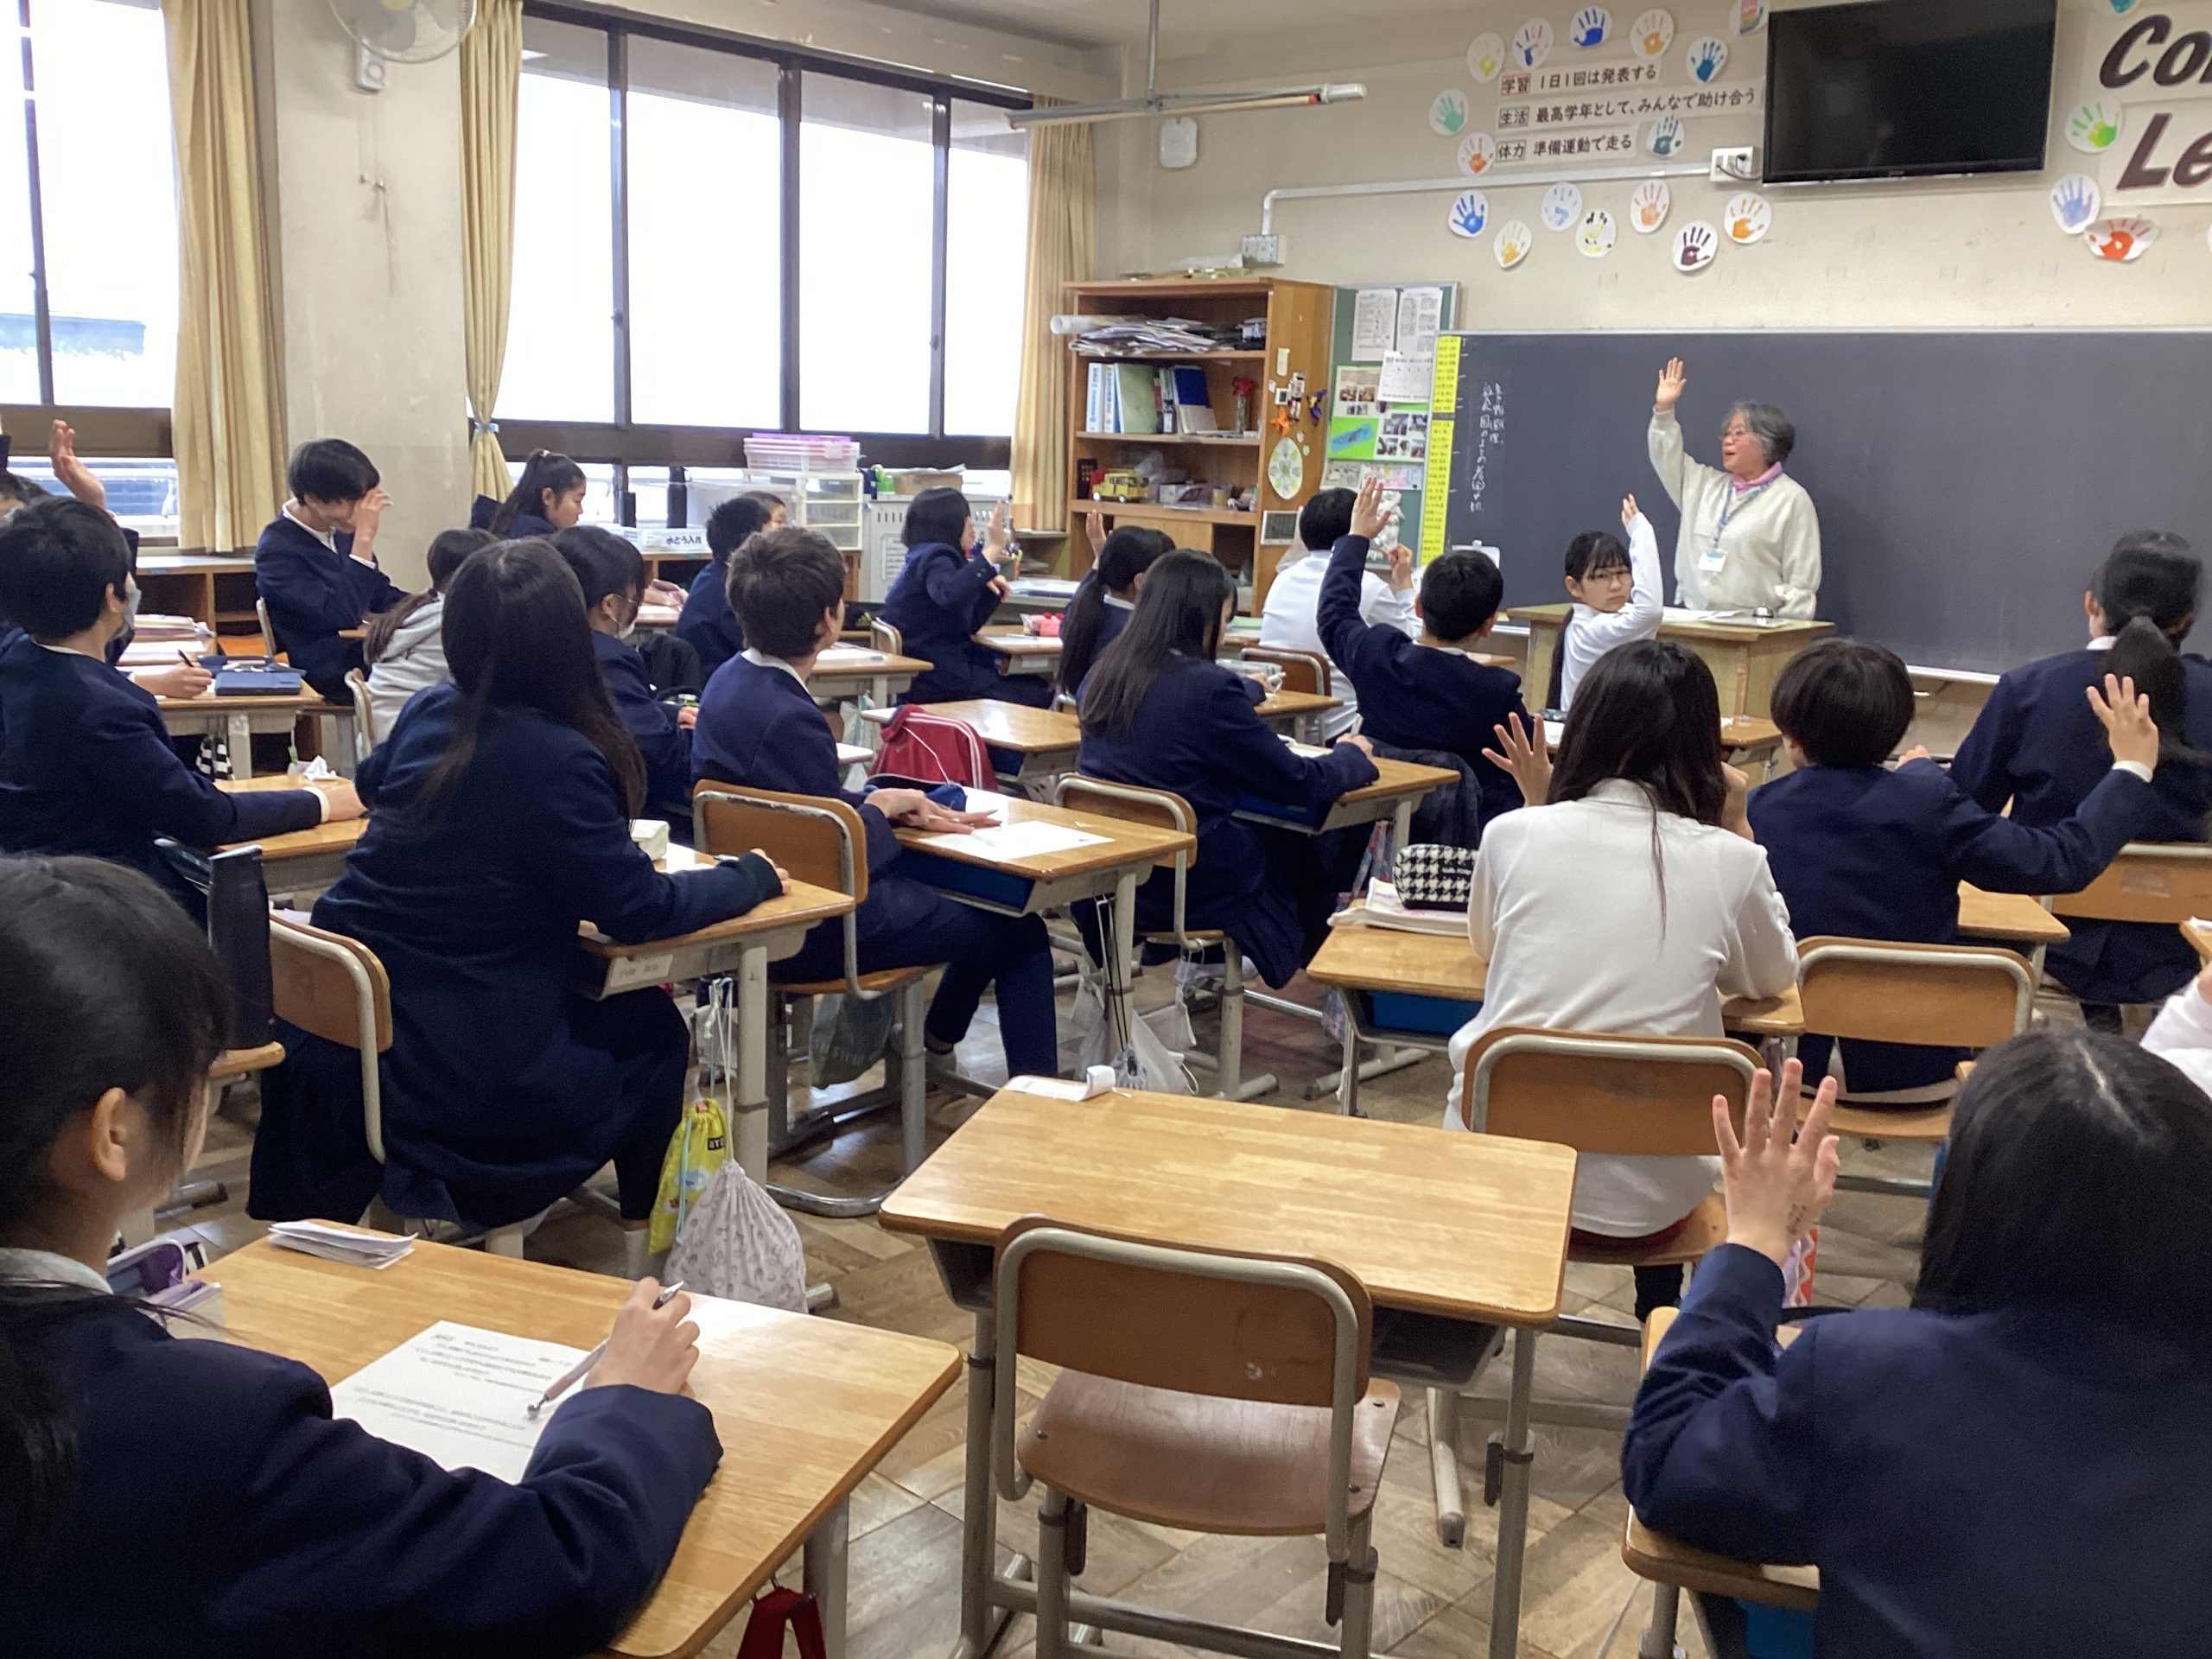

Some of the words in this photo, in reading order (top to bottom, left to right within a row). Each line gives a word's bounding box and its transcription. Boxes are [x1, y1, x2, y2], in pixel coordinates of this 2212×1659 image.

[2099, 14, 2212, 89] Co
[1502, 74, 1529, 93] 学習
[1499, 109, 1528, 125] 生活
[1536, 88, 1755, 124] 最高学年として、みんなで助け合う
[1498, 142, 1526, 159] 体力
[1534, 134, 1632, 156] 準備運動で走る
